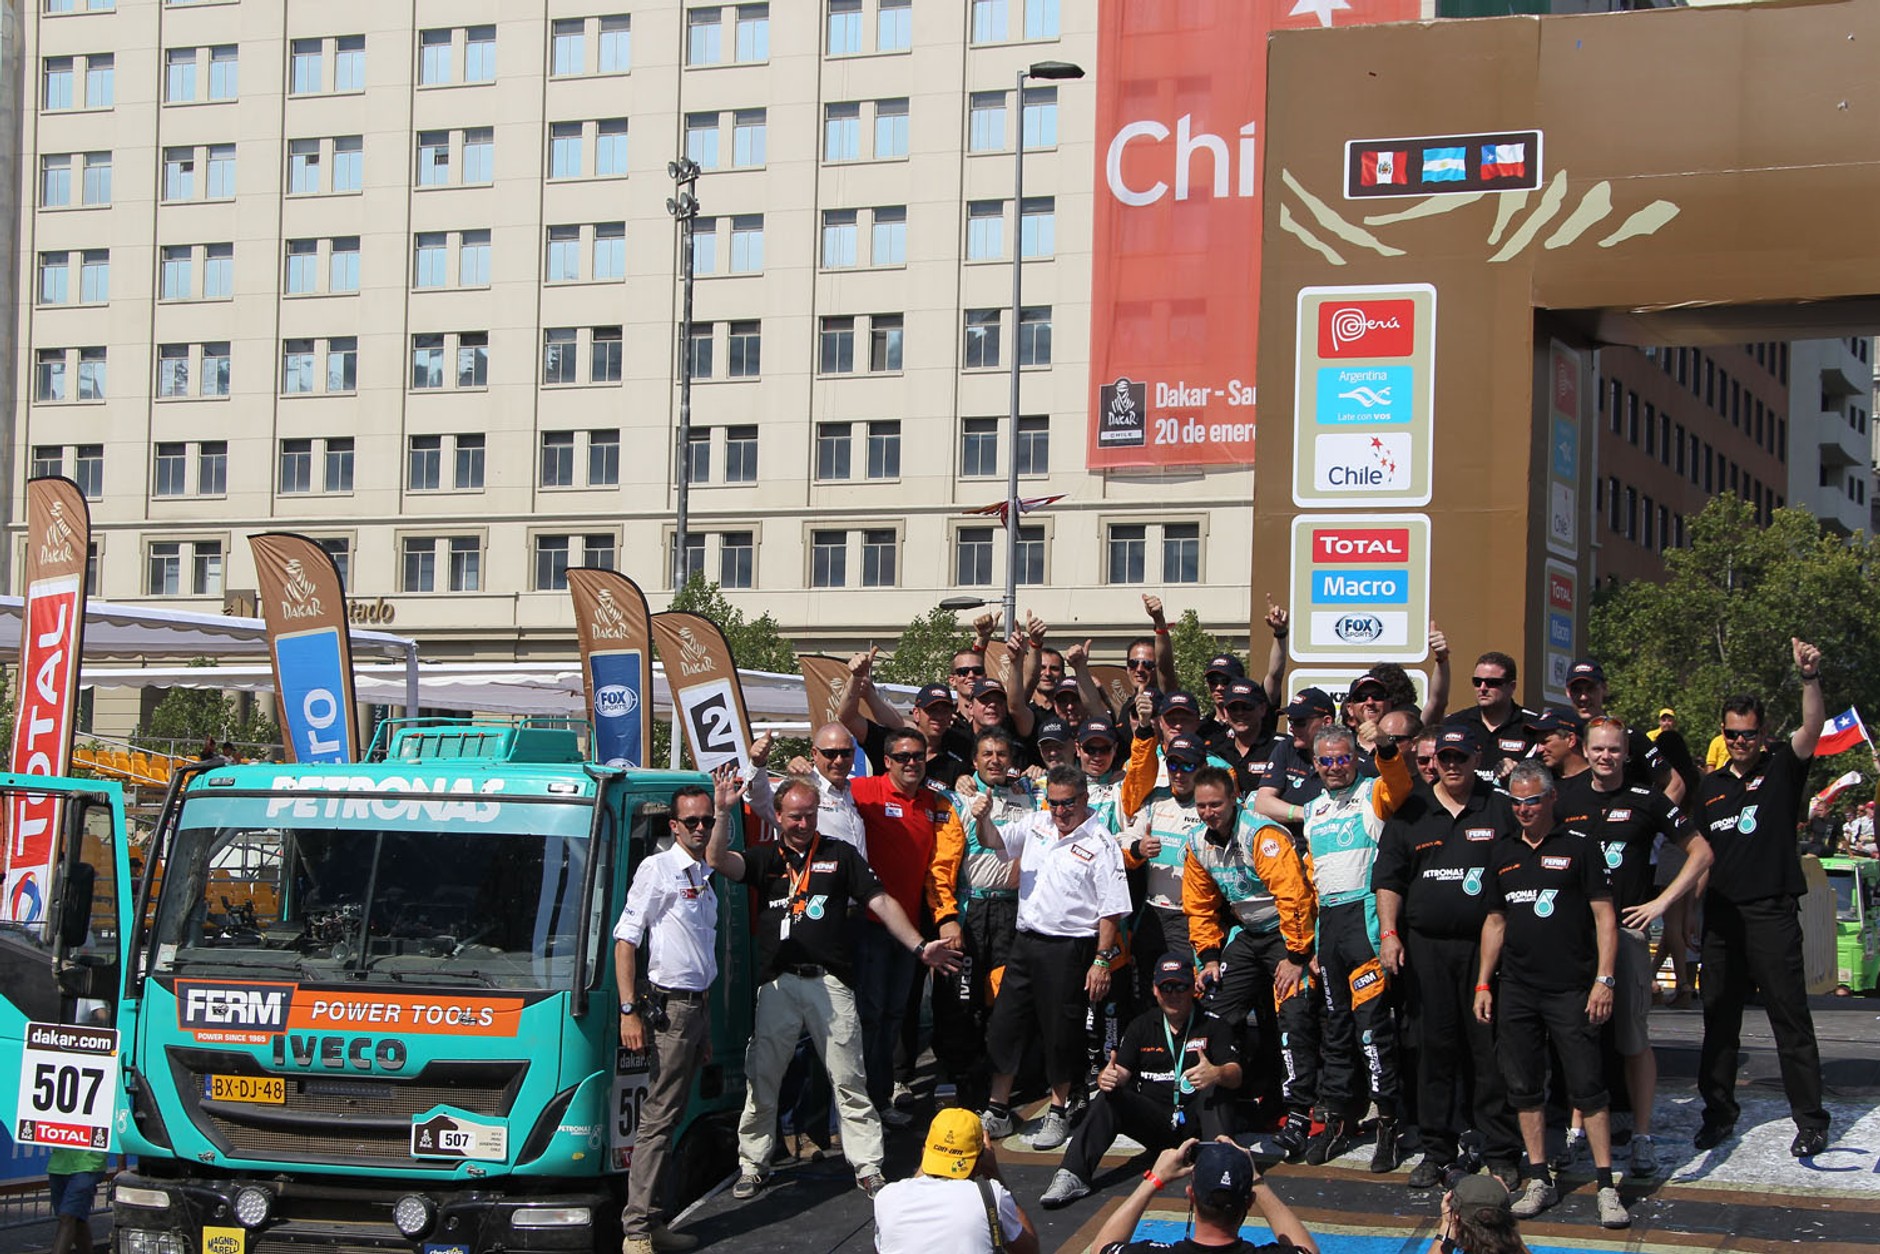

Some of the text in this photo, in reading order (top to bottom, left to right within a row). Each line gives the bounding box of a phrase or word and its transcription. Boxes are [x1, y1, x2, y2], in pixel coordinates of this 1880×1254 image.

[1331, 308, 1400, 351] Perú
[1338, 370, 1388, 383] Argentina
[1156, 381, 1210, 408] Dakar
[1108, 411, 1137, 426] DAKAR
[1337, 412, 1355, 421] Late
[1154, 418, 1179, 445] 20
[1182, 417, 1206, 444] de
[1328, 466, 1383, 485] Chile
[1319, 536, 1402, 554] TOTAL
[1323, 576, 1396, 596] Macro
[281, 597, 324, 620] DAKAR
[591, 622, 630, 640] DAKAR
[1345, 619, 1373, 632] FOX
[679, 656, 717, 677] DAKAR
[601, 691, 626, 705] FOX
[601, 704, 628, 712] SPORTS
[1501, 742, 1524, 750] FERM
[266, 776, 505, 823] PETRONAS
[1468, 830, 1492, 839] FERM
[1543, 858, 1568, 867] FERM
[959, 955, 973, 1001] IVECO
[1353, 971, 1378, 991] FERM
[186, 989, 282, 1025] FERM
[311, 1000, 494, 1027] POWER TOOLS
[31, 1029, 111, 1050] dakar.com
[197, 1033, 224, 1041] POWER
[225, 1034, 246, 1042] SINCE
[272, 1034, 407, 1071] IVECO
[32, 1063, 105, 1115] 507
[215, 1078, 281, 1099] BX-DJ-48
[38, 1125, 89, 1142] TOTAL
[445, 1133, 469, 1147] 507
